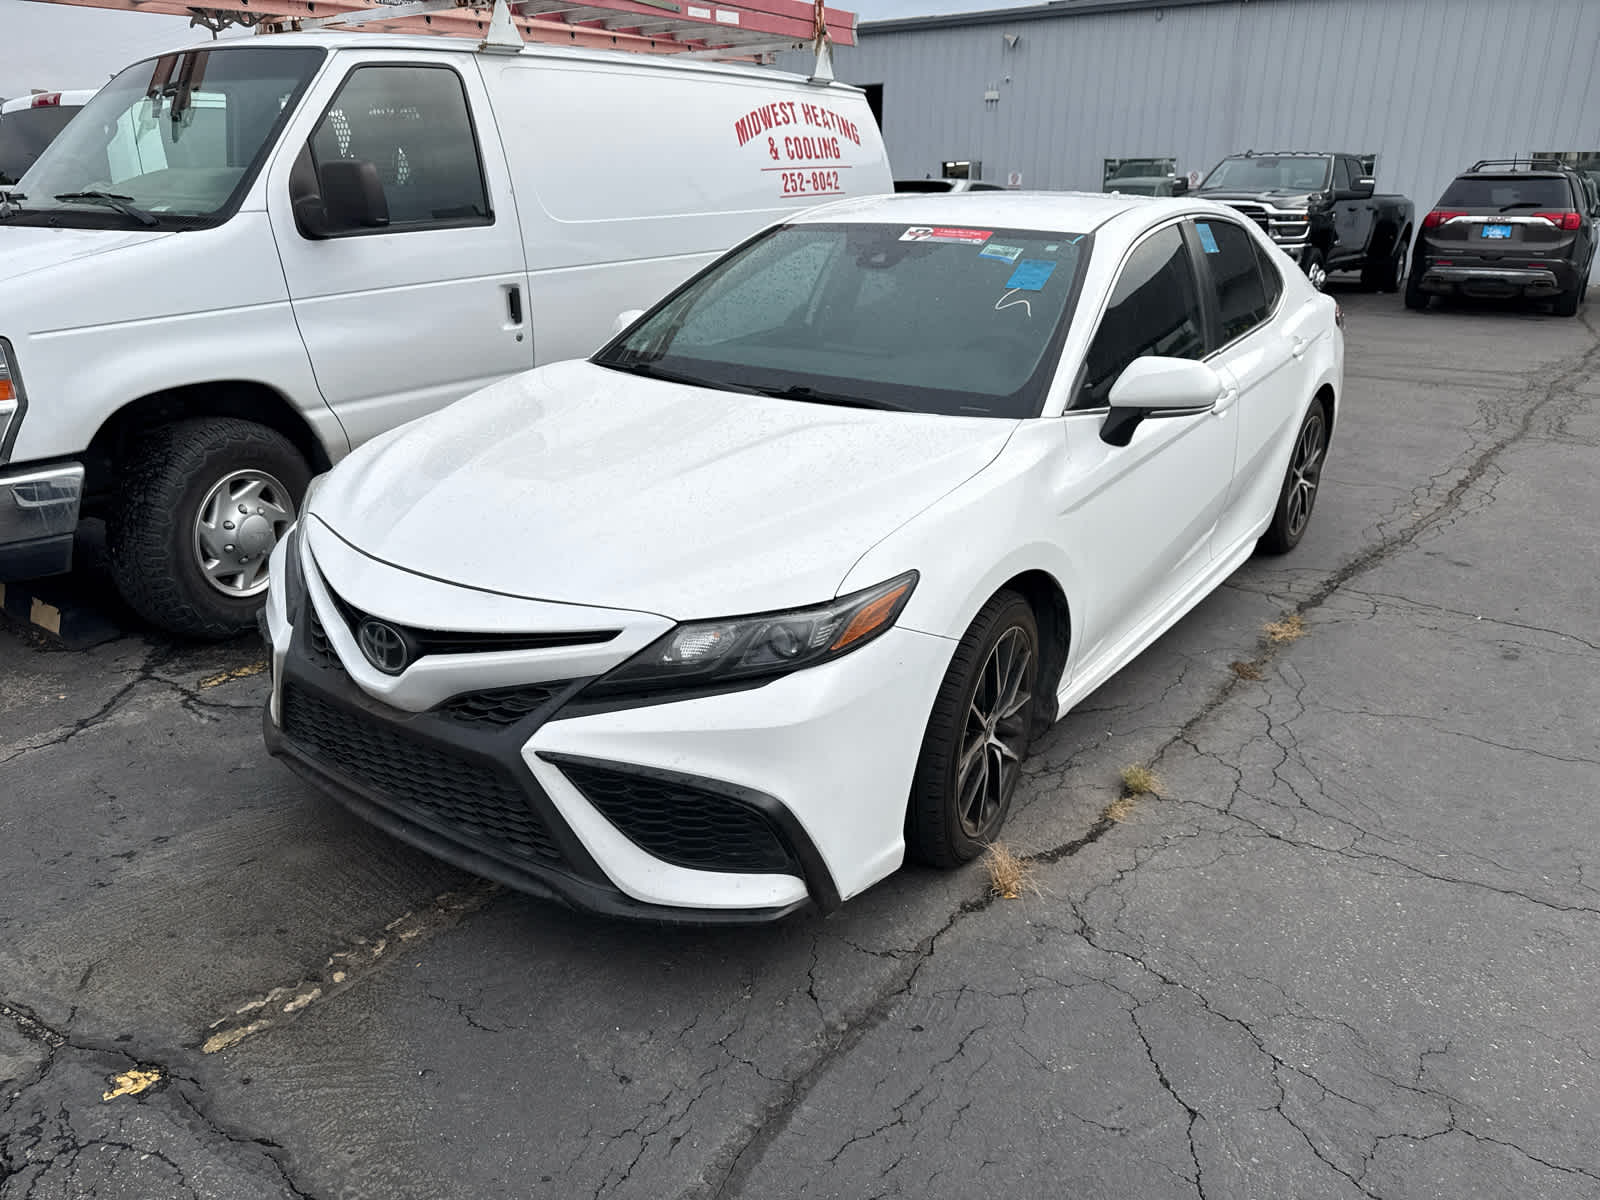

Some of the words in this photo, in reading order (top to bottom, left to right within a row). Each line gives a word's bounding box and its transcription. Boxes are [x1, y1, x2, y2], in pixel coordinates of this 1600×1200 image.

[735, 101, 797, 147] MIDWEST
[801, 102, 861, 146] HEATING
[768, 136, 780, 160] &
[784, 136, 840, 160] COOLING
[782, 171, 840, 193] 252-8042
